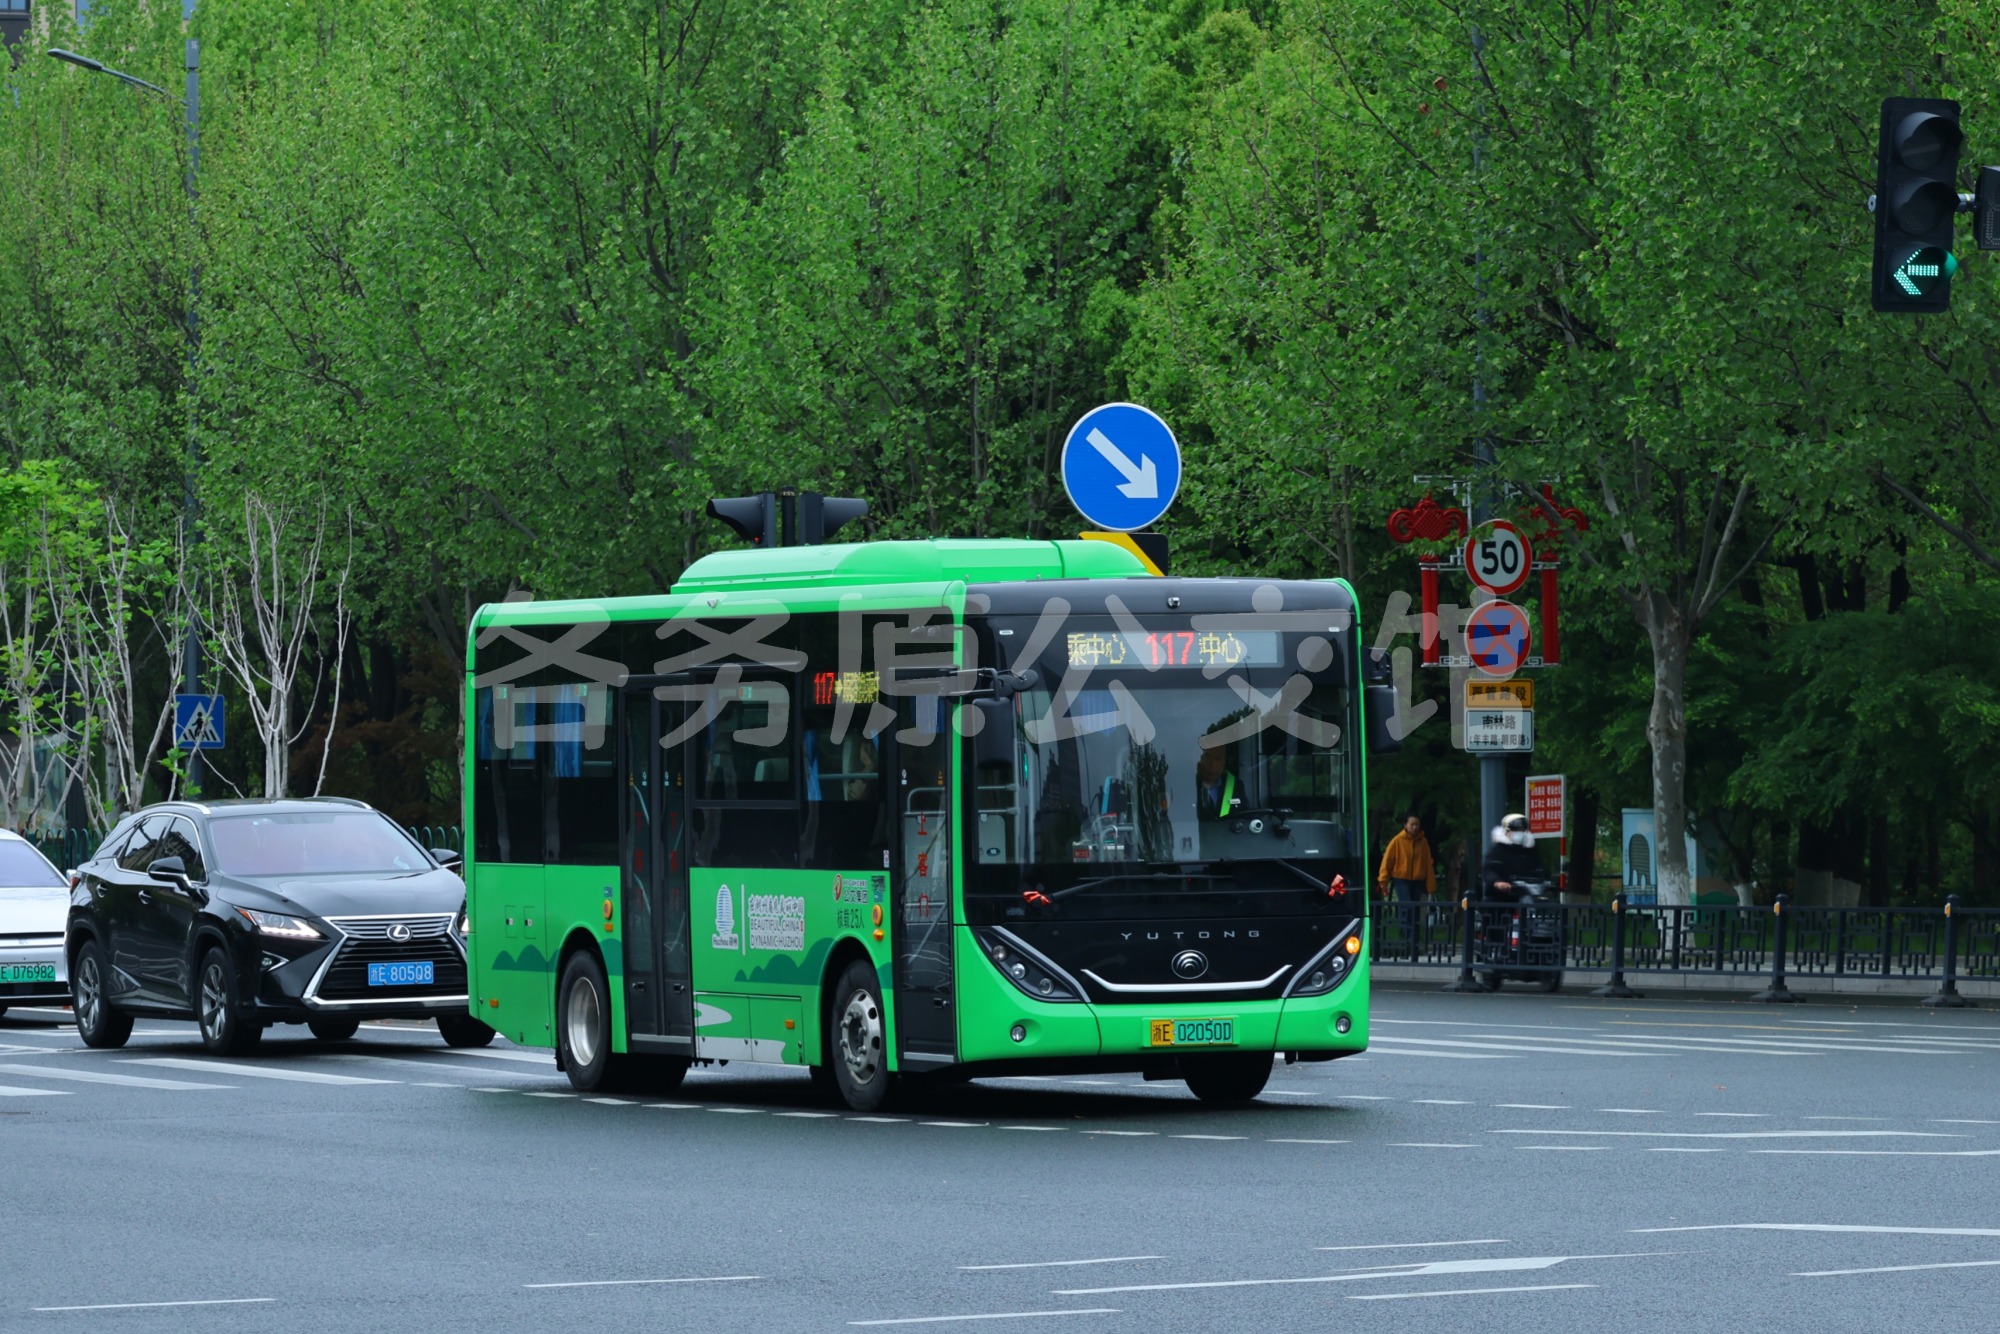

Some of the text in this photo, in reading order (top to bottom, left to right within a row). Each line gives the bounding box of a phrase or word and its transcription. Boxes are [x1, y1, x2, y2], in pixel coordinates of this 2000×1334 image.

[1481, 540, 1519, 575] 50
[1145, 632, 1195, 665] 117
[814, 672, 835, 705] 117
[1472, 686, 1527, 701] 严管路段
[1482, 714, 1516, 730] 南林路
[750, 918, 799, 932] BEAUTIFUL CHINA
[1121, 930, 1260, 940] YUTONG
